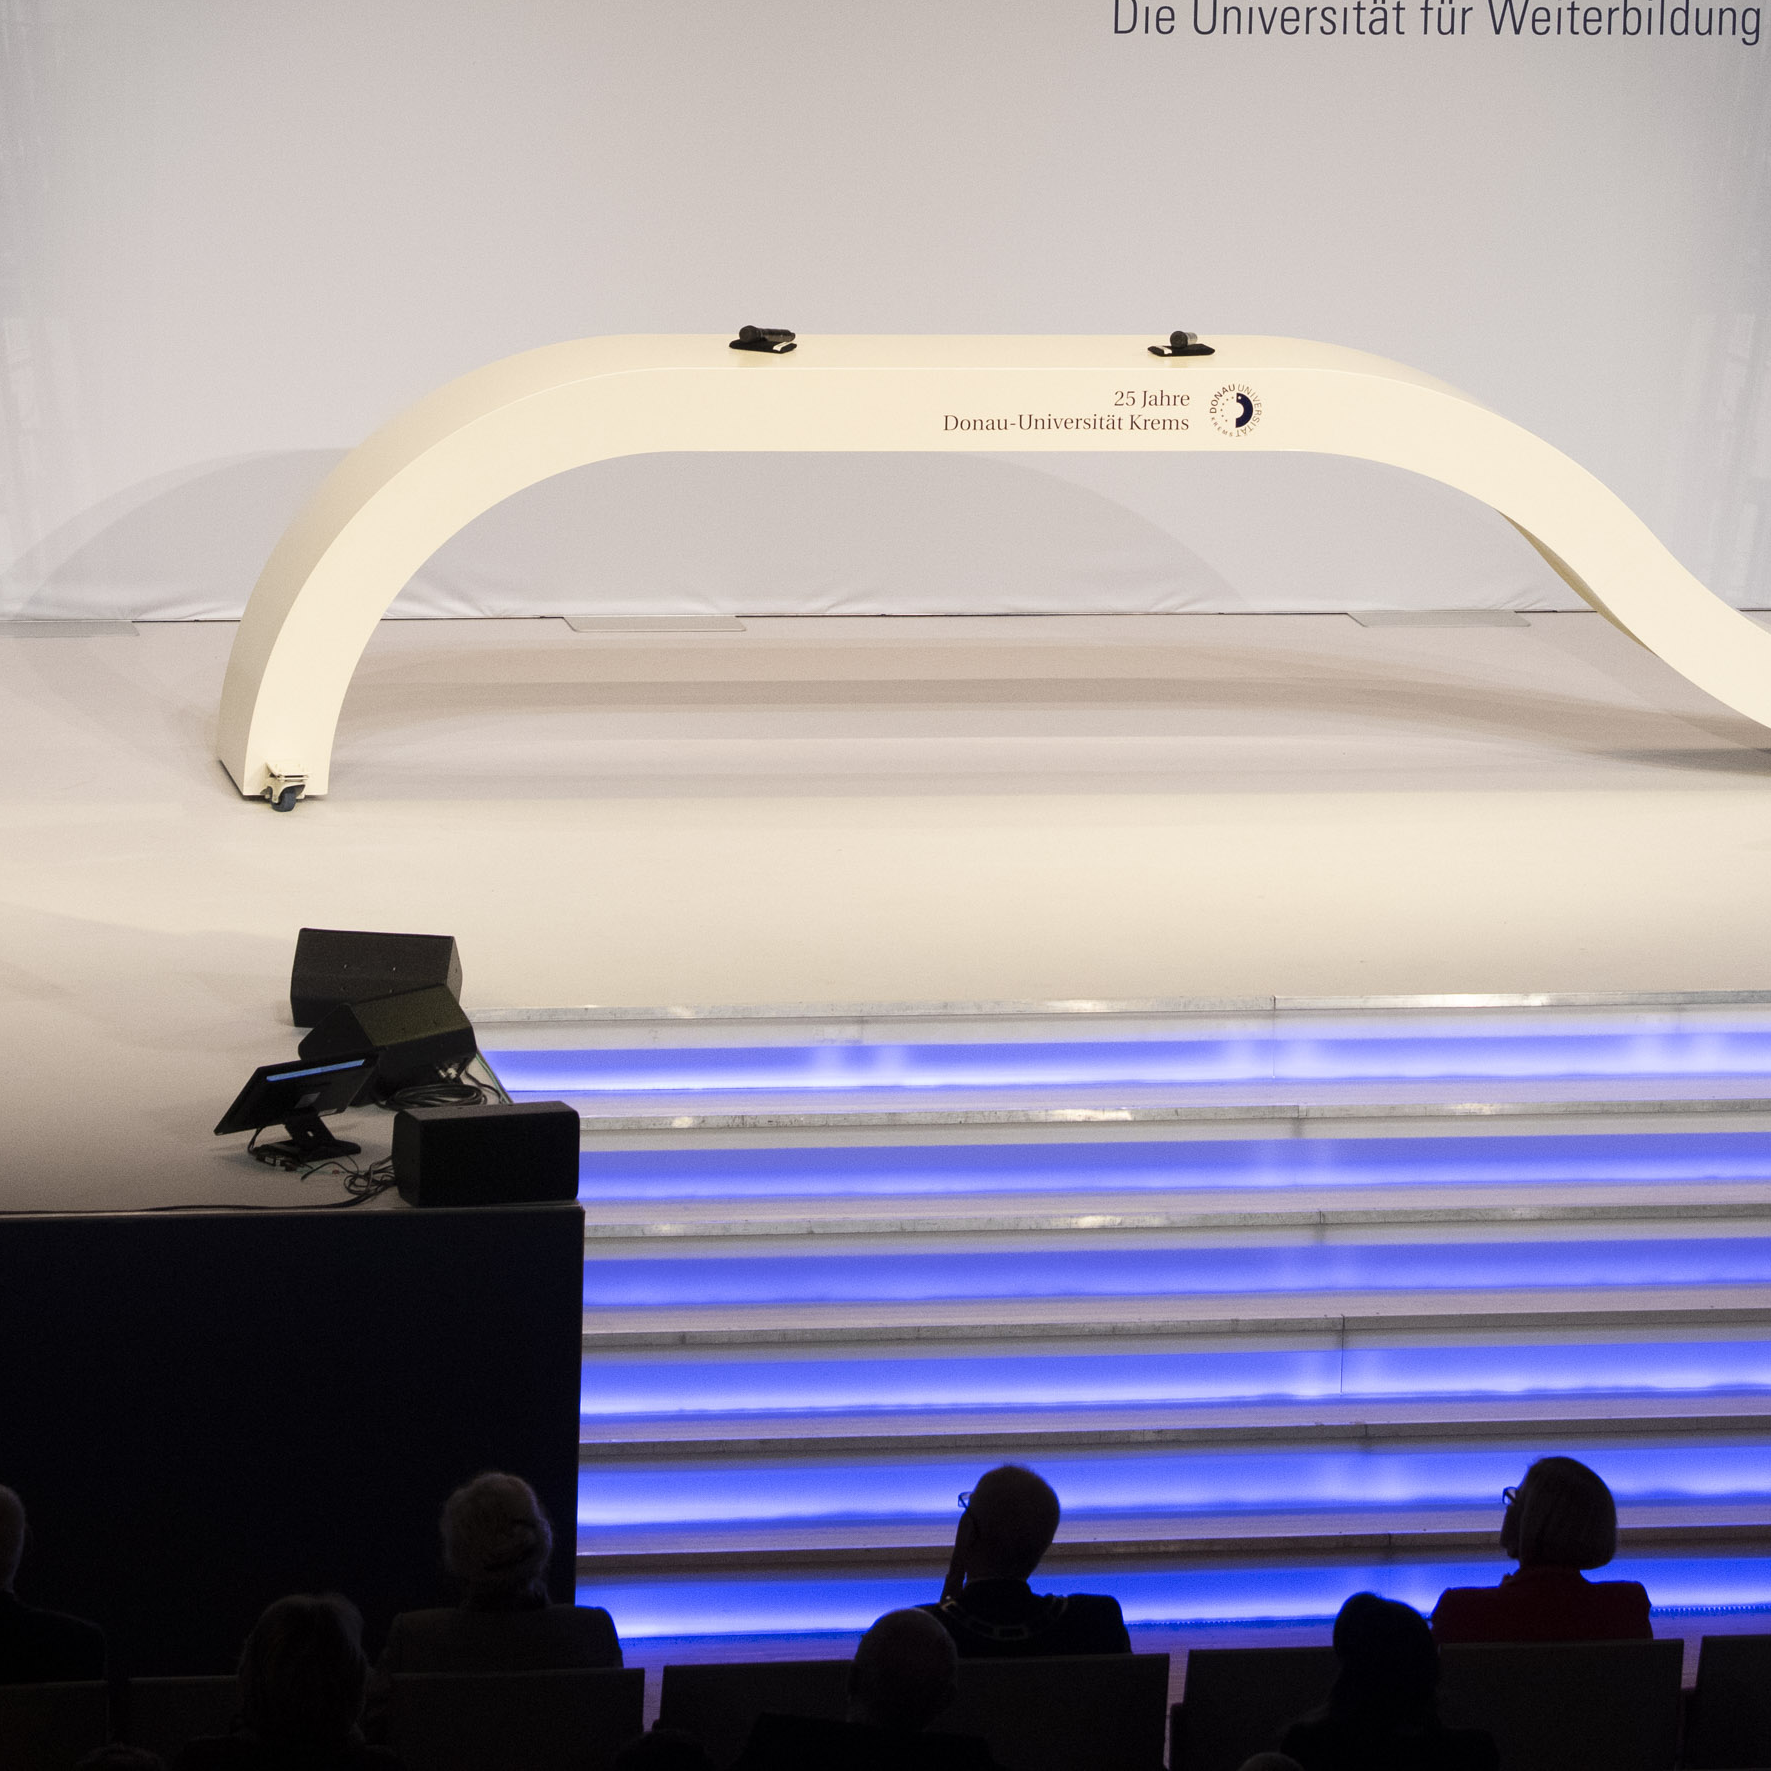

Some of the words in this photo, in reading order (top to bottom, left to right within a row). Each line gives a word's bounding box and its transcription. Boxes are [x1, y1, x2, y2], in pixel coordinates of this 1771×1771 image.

[1113, 390, 1136, 407] 25
[1142, 389, 1191, 408] Jahre
[944, 413, 1122, 431] Donau-Universität
[1129, 414, 1190, 431] Krems
